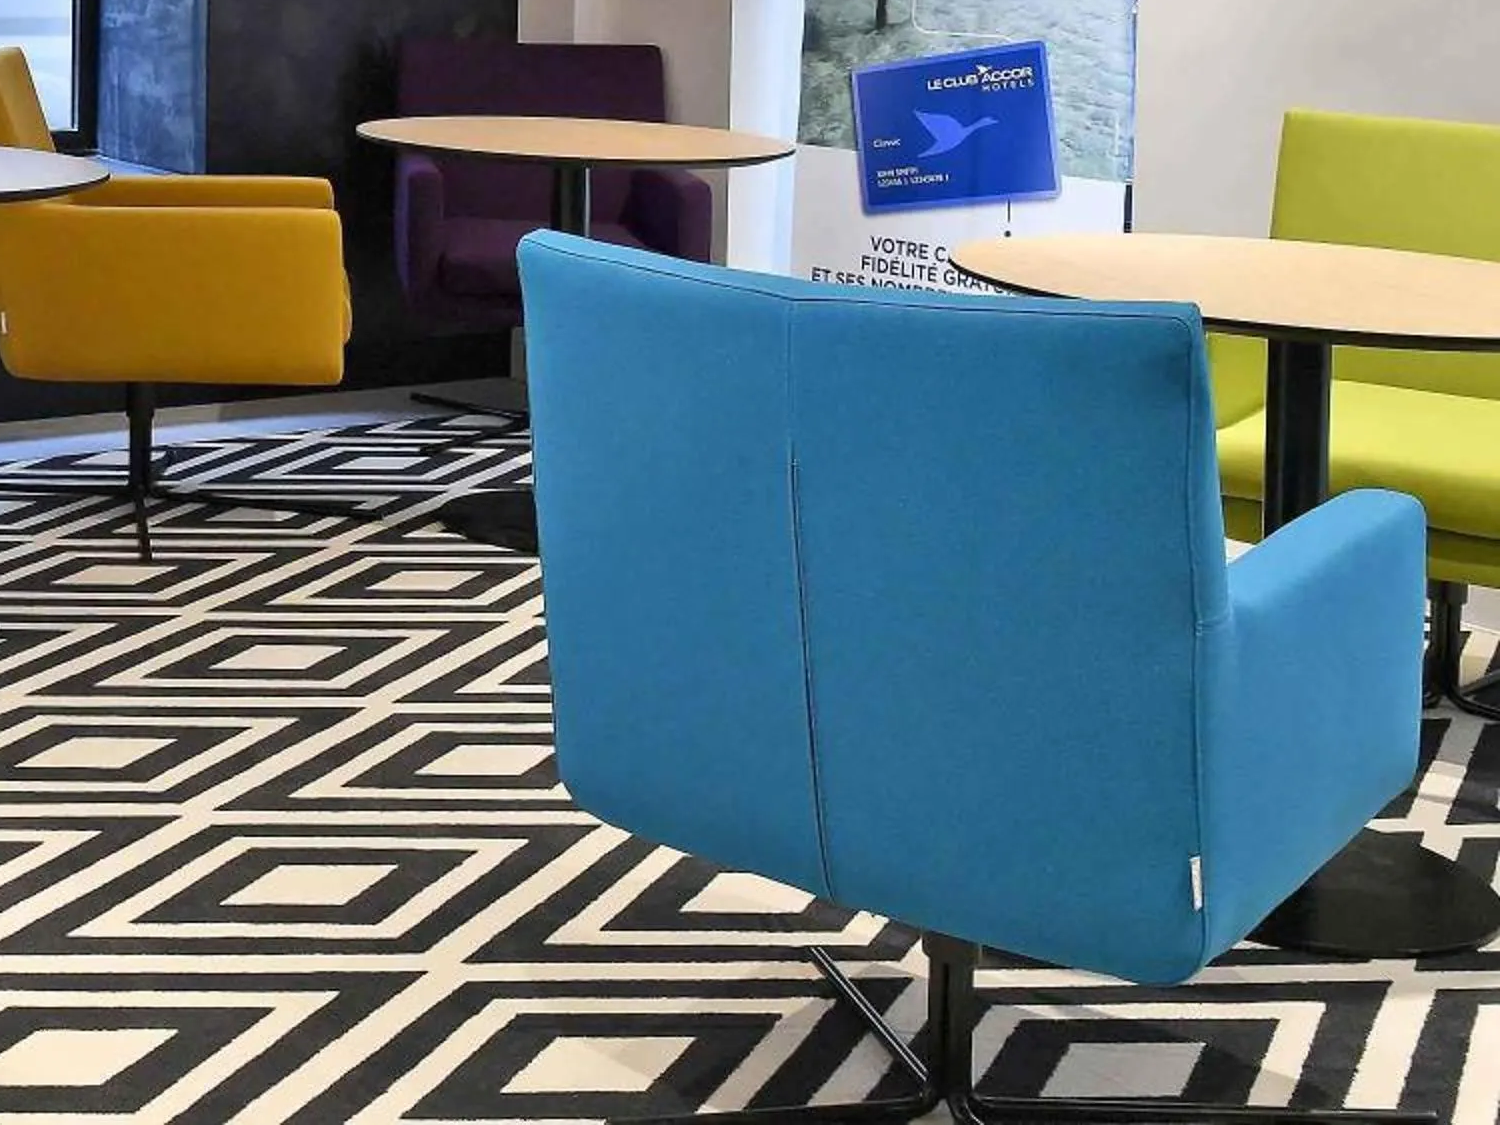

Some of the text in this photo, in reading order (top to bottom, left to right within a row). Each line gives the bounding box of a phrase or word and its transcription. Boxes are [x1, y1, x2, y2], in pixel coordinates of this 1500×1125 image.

[927, 79, 942, 90] LE
[981, 66, 1033, 83] ACCOR
[870, 235, 929, 259] VOTRE
[811, 266, 831, 283] ET
[861, 254, 937, 282] FIDÉLITÉ
